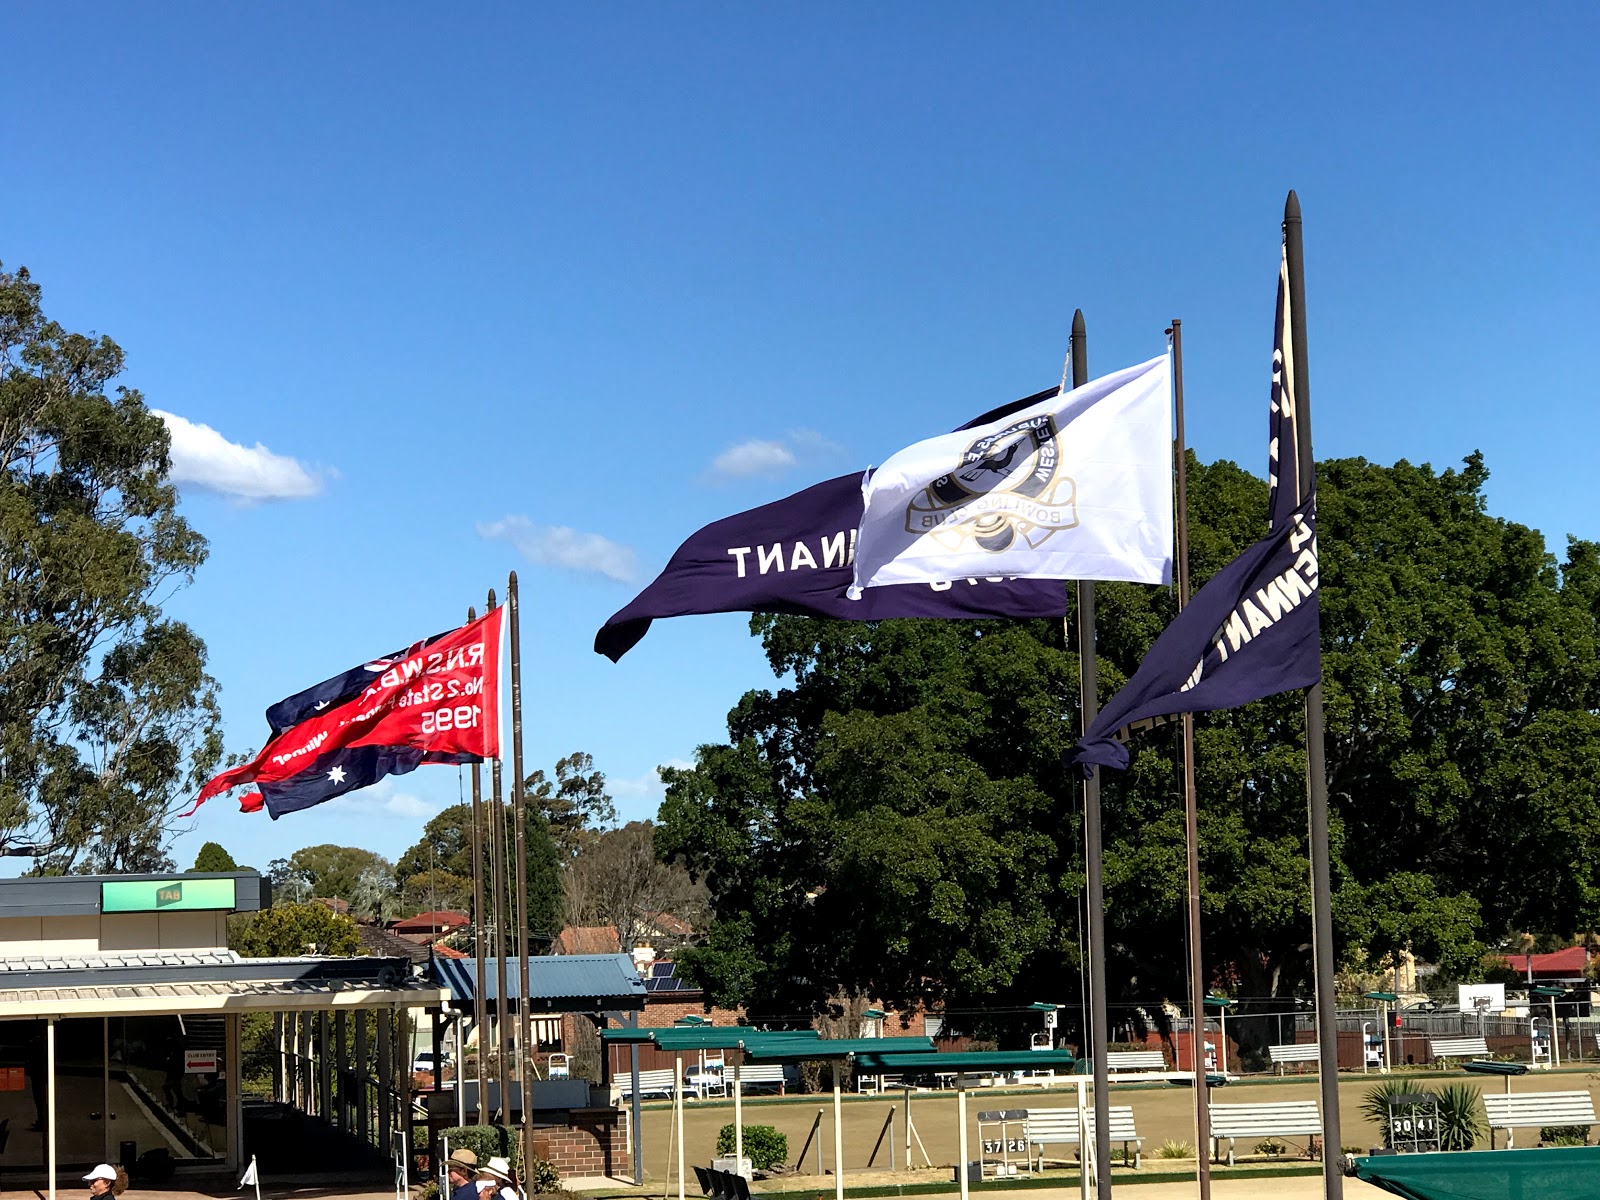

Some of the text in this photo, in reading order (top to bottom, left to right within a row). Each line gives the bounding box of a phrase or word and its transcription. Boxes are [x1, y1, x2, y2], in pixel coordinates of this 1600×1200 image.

[158, 890, 180, 900] TAB
[1047, 1013, 1054, 1024] 3
[1394, 1118, 1433, 1132] 30 41
[984, 1140, 1025, 1154] 37 26
